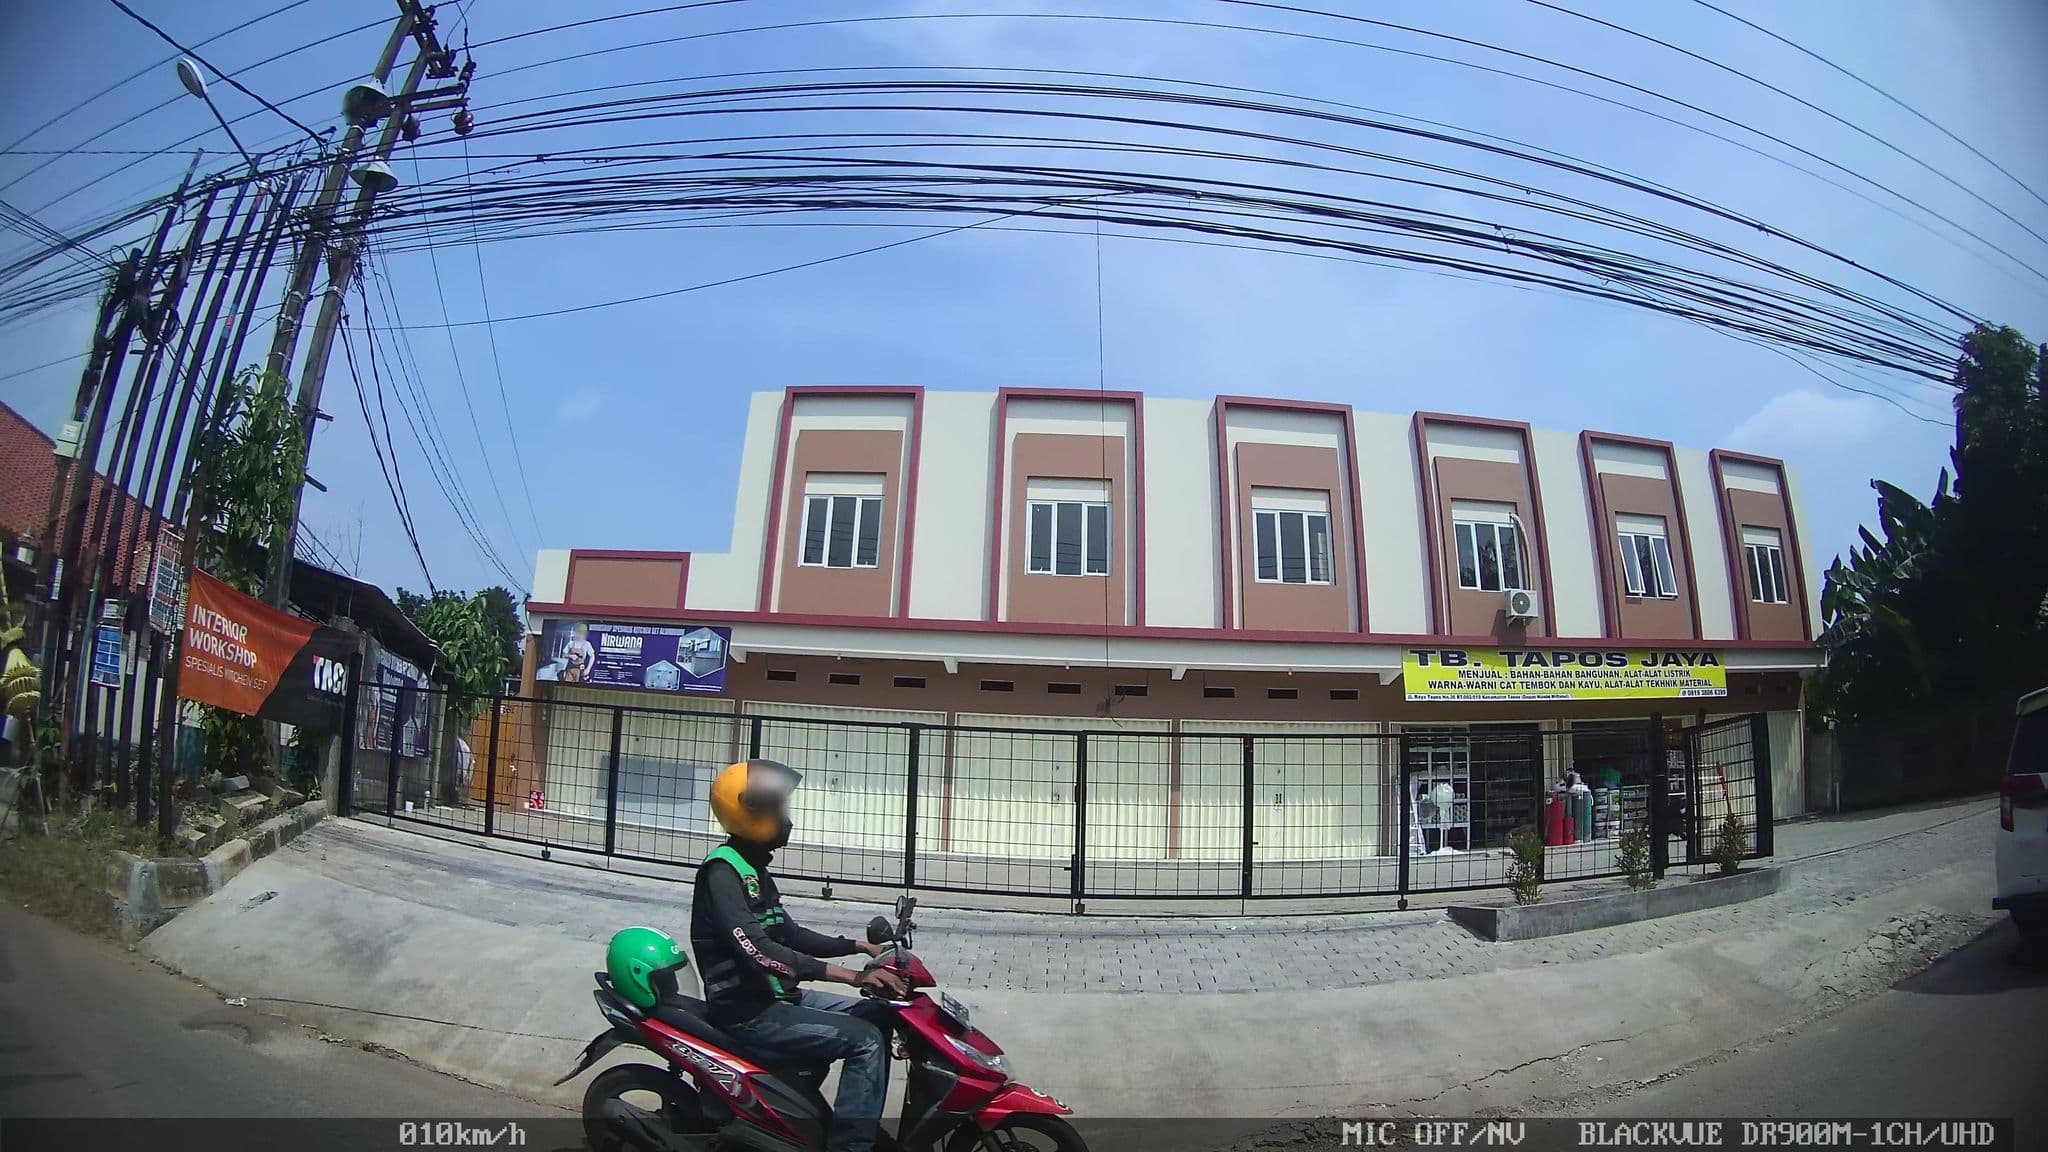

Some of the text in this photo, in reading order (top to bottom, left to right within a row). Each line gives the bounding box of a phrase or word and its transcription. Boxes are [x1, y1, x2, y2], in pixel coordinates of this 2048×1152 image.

[192, 604, 248, 644] INTERIOR
[190, 628, 257, 669] WORKSHOP
[601, 632, 643, 649] NIRWANA
[1409, 650, 1720, 667] TB. TAPOS JAYA
[185, 655, 224, 678] SPESIALIS
[252, 678, 267, 690] SET
[1458, 670, 1503, 679] MENJUAL
[1510, 670, 1573, 679] BAHAN-BAHAN
[1624, 670, 1662, 678] ALAT-ALAT
[1664, 669, 1691, 678] LISTRIK
[1428, 680, 1497, 690] WARNA-WARNI
[1500, 681, 1517, 689] CAT
[1519, 681, 1556, 689] TEMBOK
[1559, 681, 1576, 689] DAN
[1604, 680, 1644, 689] ALAT-ALAT
[1646, 679, 1678, 688] TEKHNIK
[1679, 679, 1713, 688] MATERIAL
